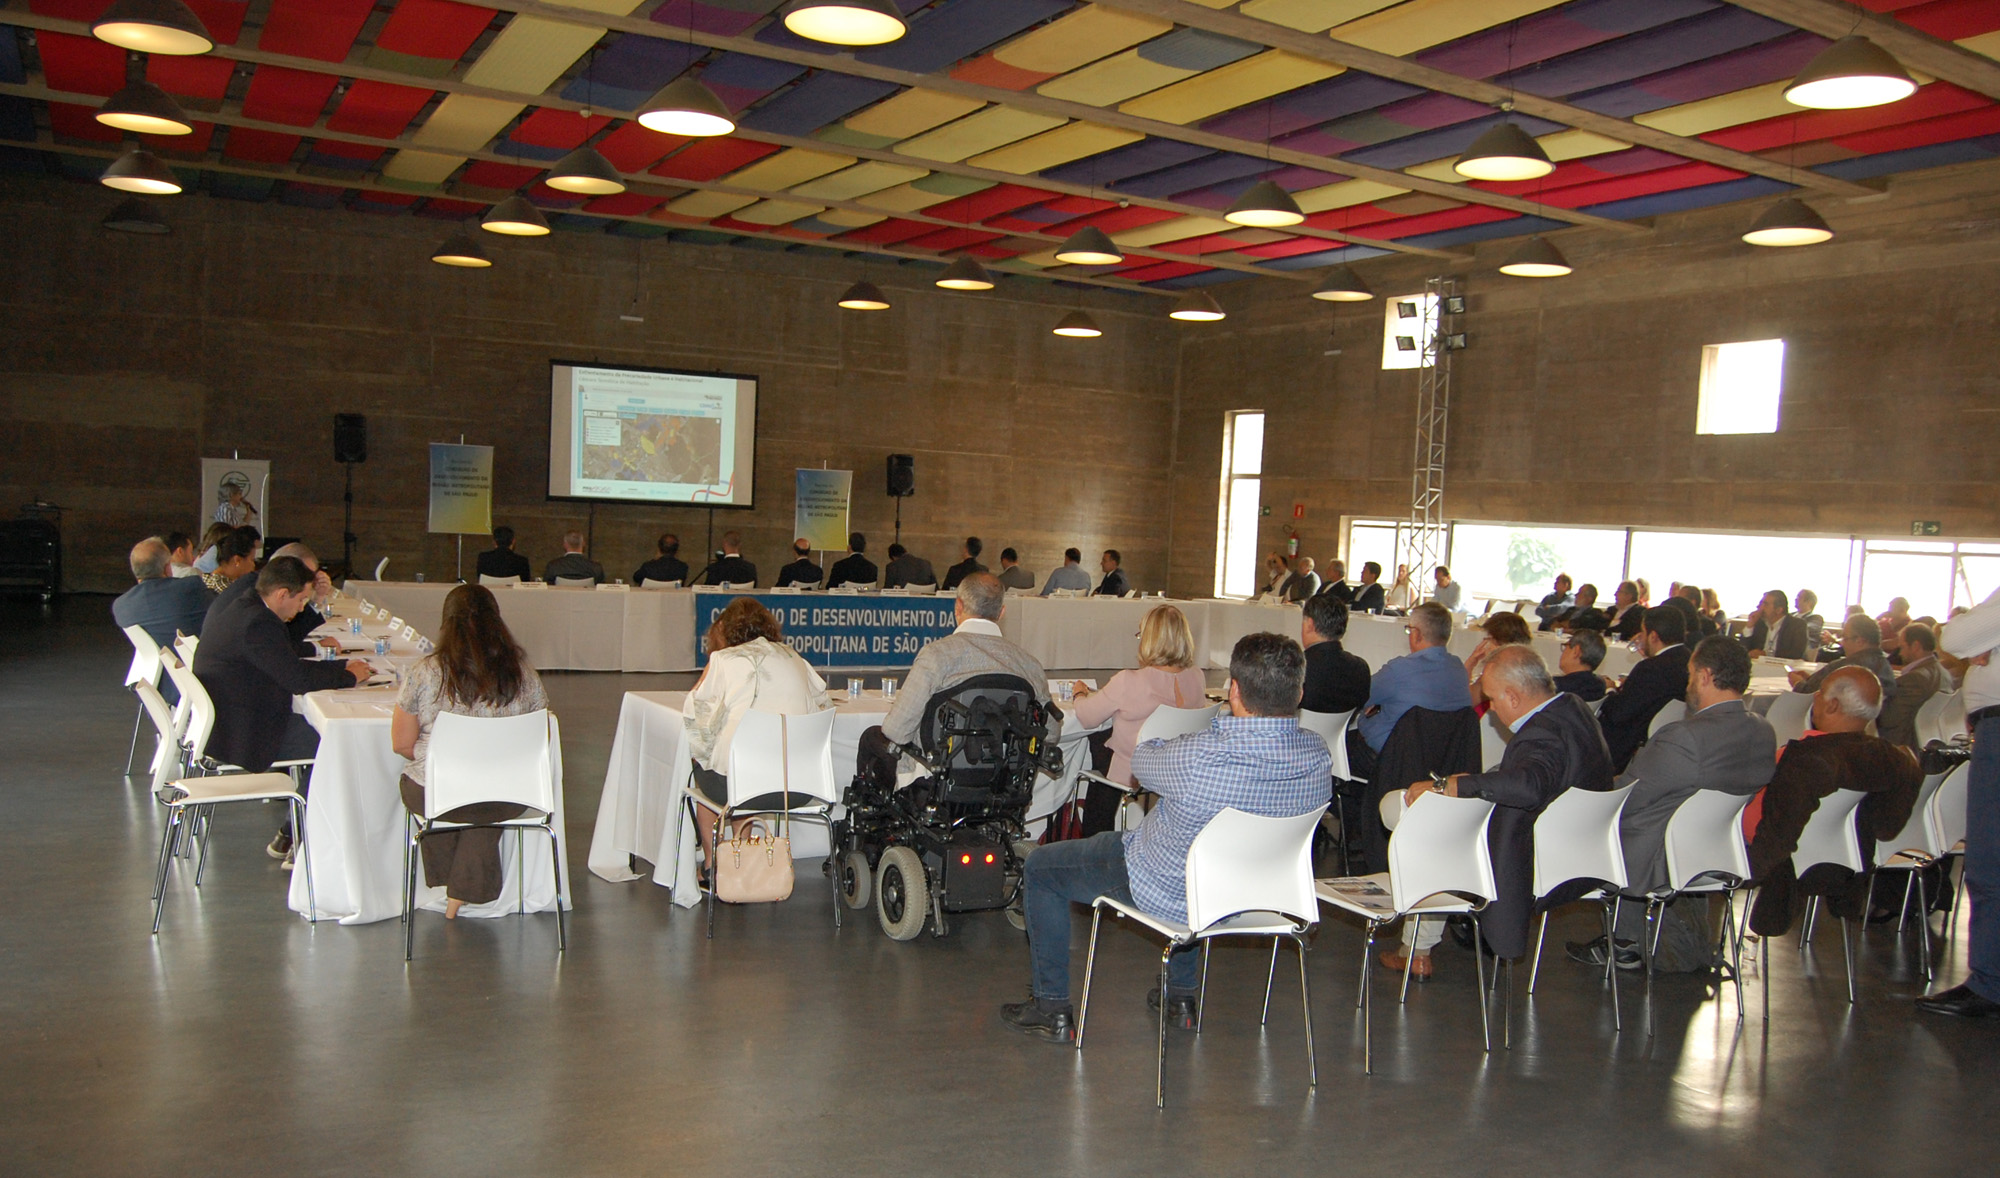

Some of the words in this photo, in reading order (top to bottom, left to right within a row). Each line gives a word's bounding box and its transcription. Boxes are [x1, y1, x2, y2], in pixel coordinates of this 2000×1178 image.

[790, 608, 808, 626] DE
[812, 608, 935, 628] DESENVOLVIMENTO
[939, 610, 956, 628] DA
[786, 635, 868, 654] ROPOLITANA
[872, 636, 889, 654] DE
[893, 631, 918, 654] SÃO
